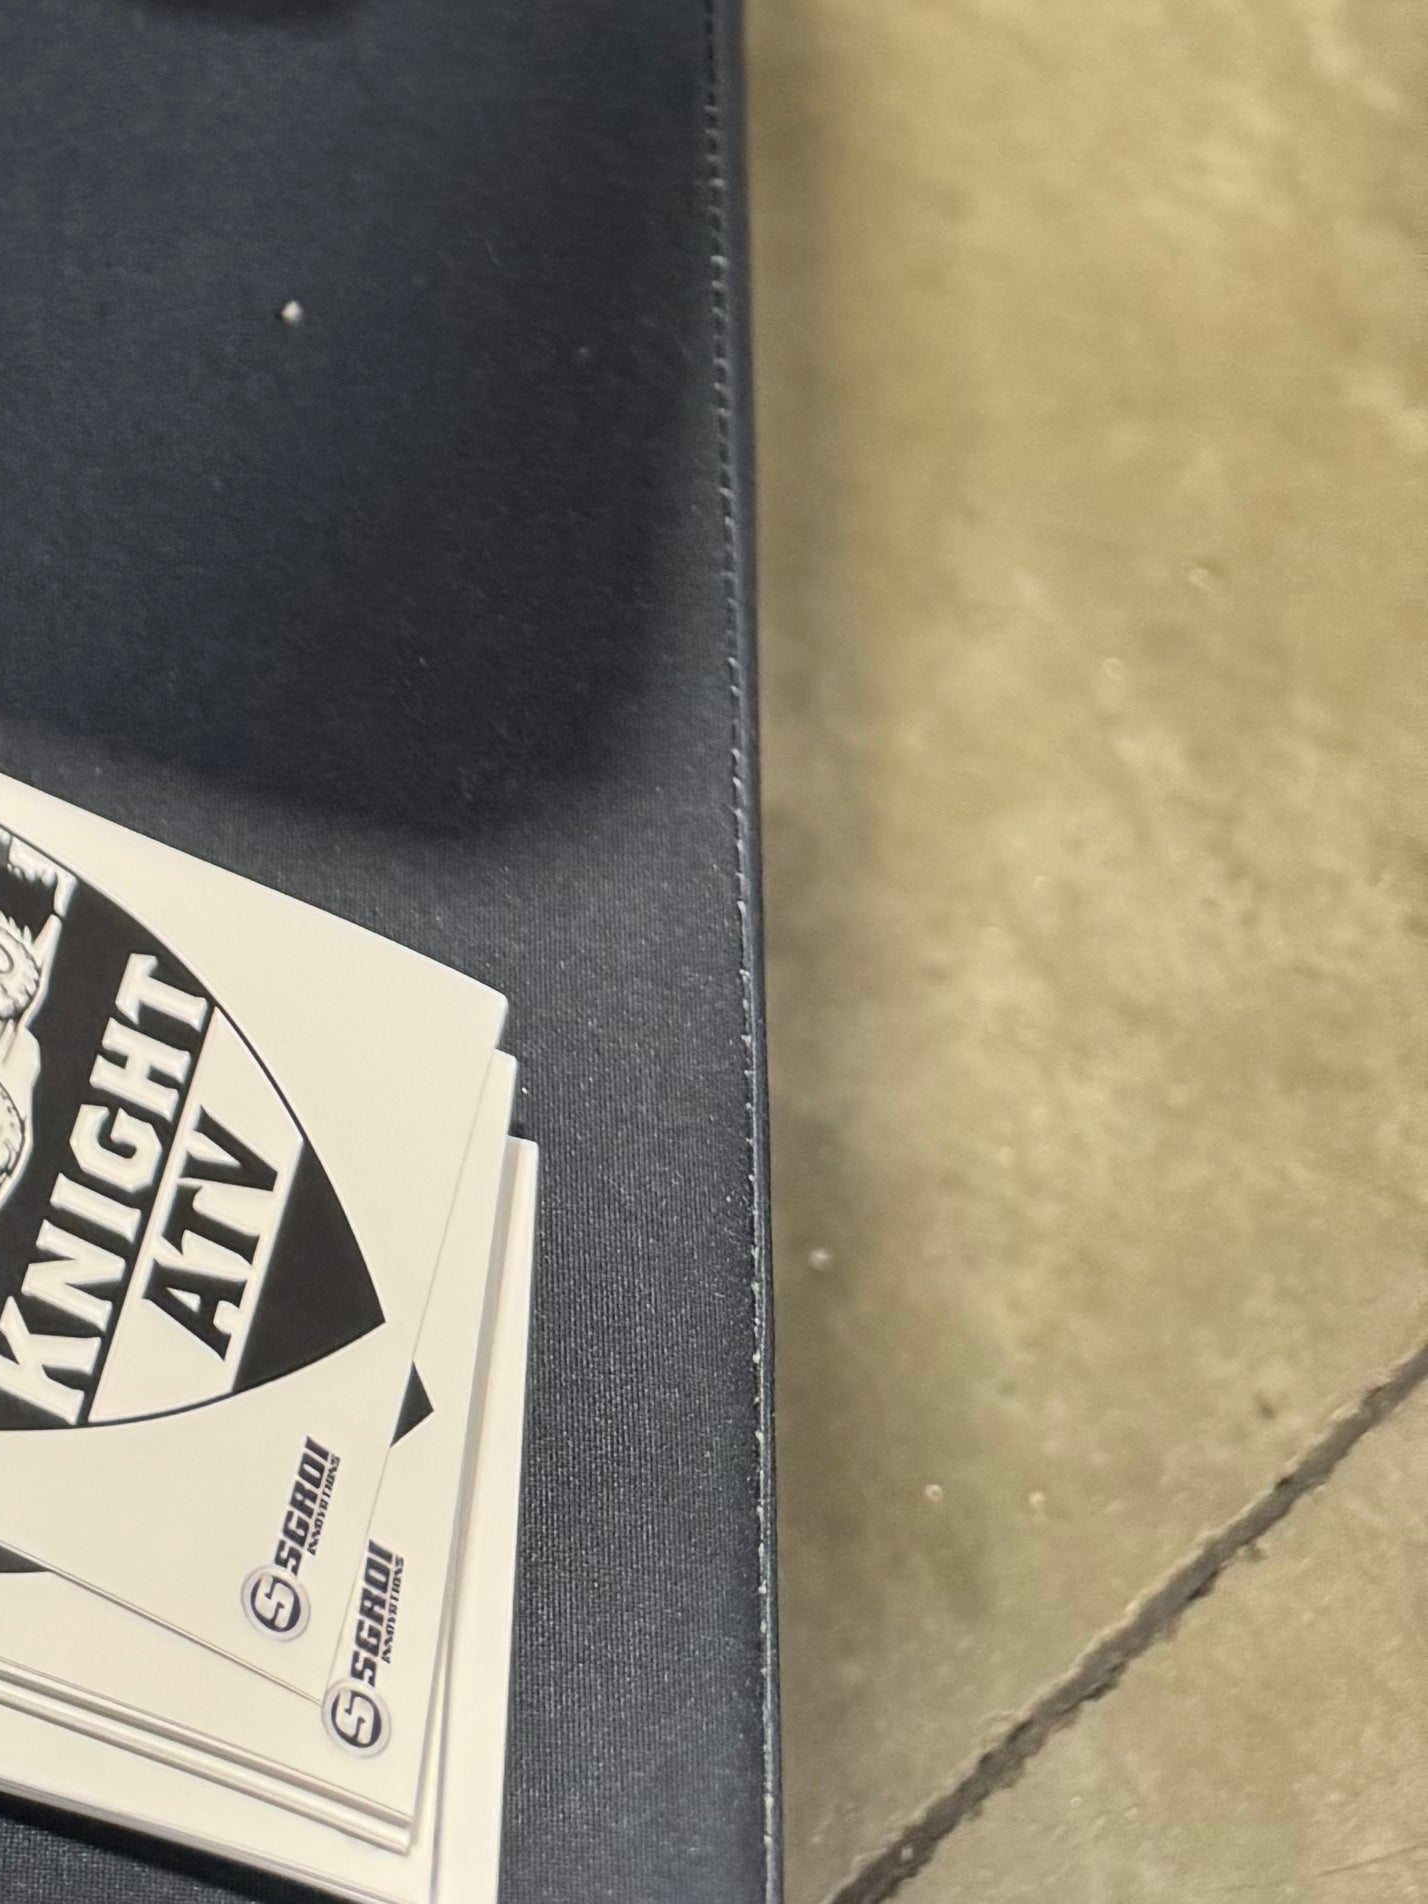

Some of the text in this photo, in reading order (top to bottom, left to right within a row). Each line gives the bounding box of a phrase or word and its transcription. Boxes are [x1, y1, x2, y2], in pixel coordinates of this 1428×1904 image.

[142, 1104, 279, 1362] ATV
[274, 1436, 330, 1576] SGROI
[350, 1539, 394, 1687] SGROI
